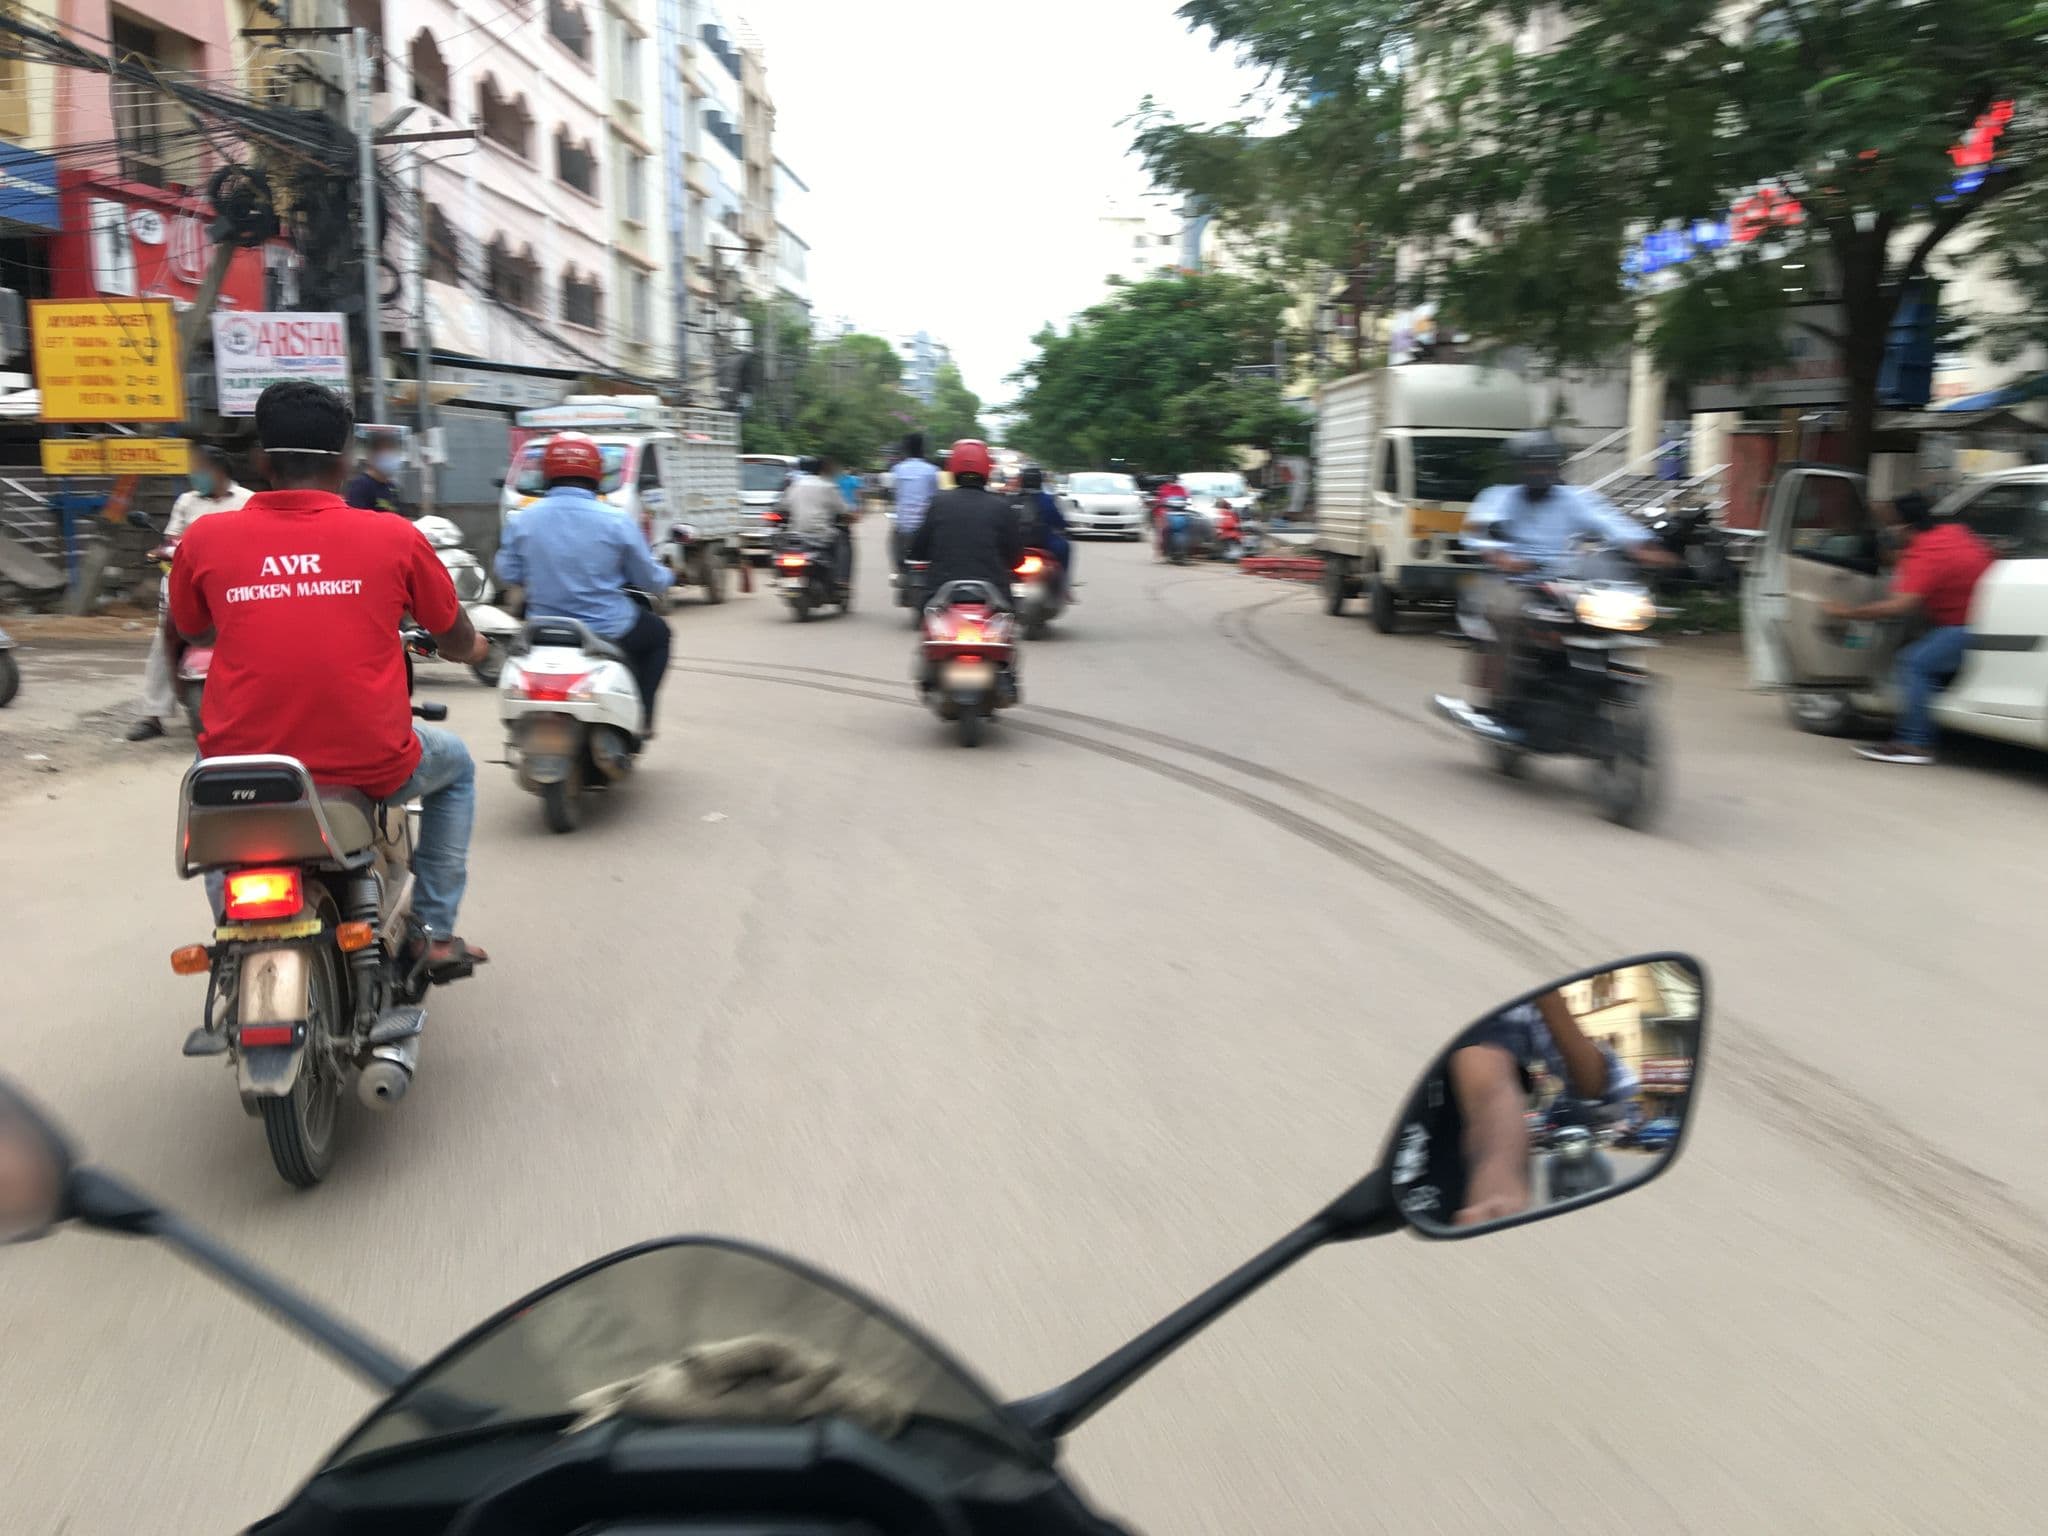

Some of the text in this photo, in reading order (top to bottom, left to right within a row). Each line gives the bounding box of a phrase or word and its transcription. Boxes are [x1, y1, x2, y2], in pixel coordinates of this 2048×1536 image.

[256, 321, 347, 356] ARSHA
[260, 554, 321, 577] AVR
[226, 579, 362, 604] CHICKEN MARKET
[231, 789, 257, 801] TVS
